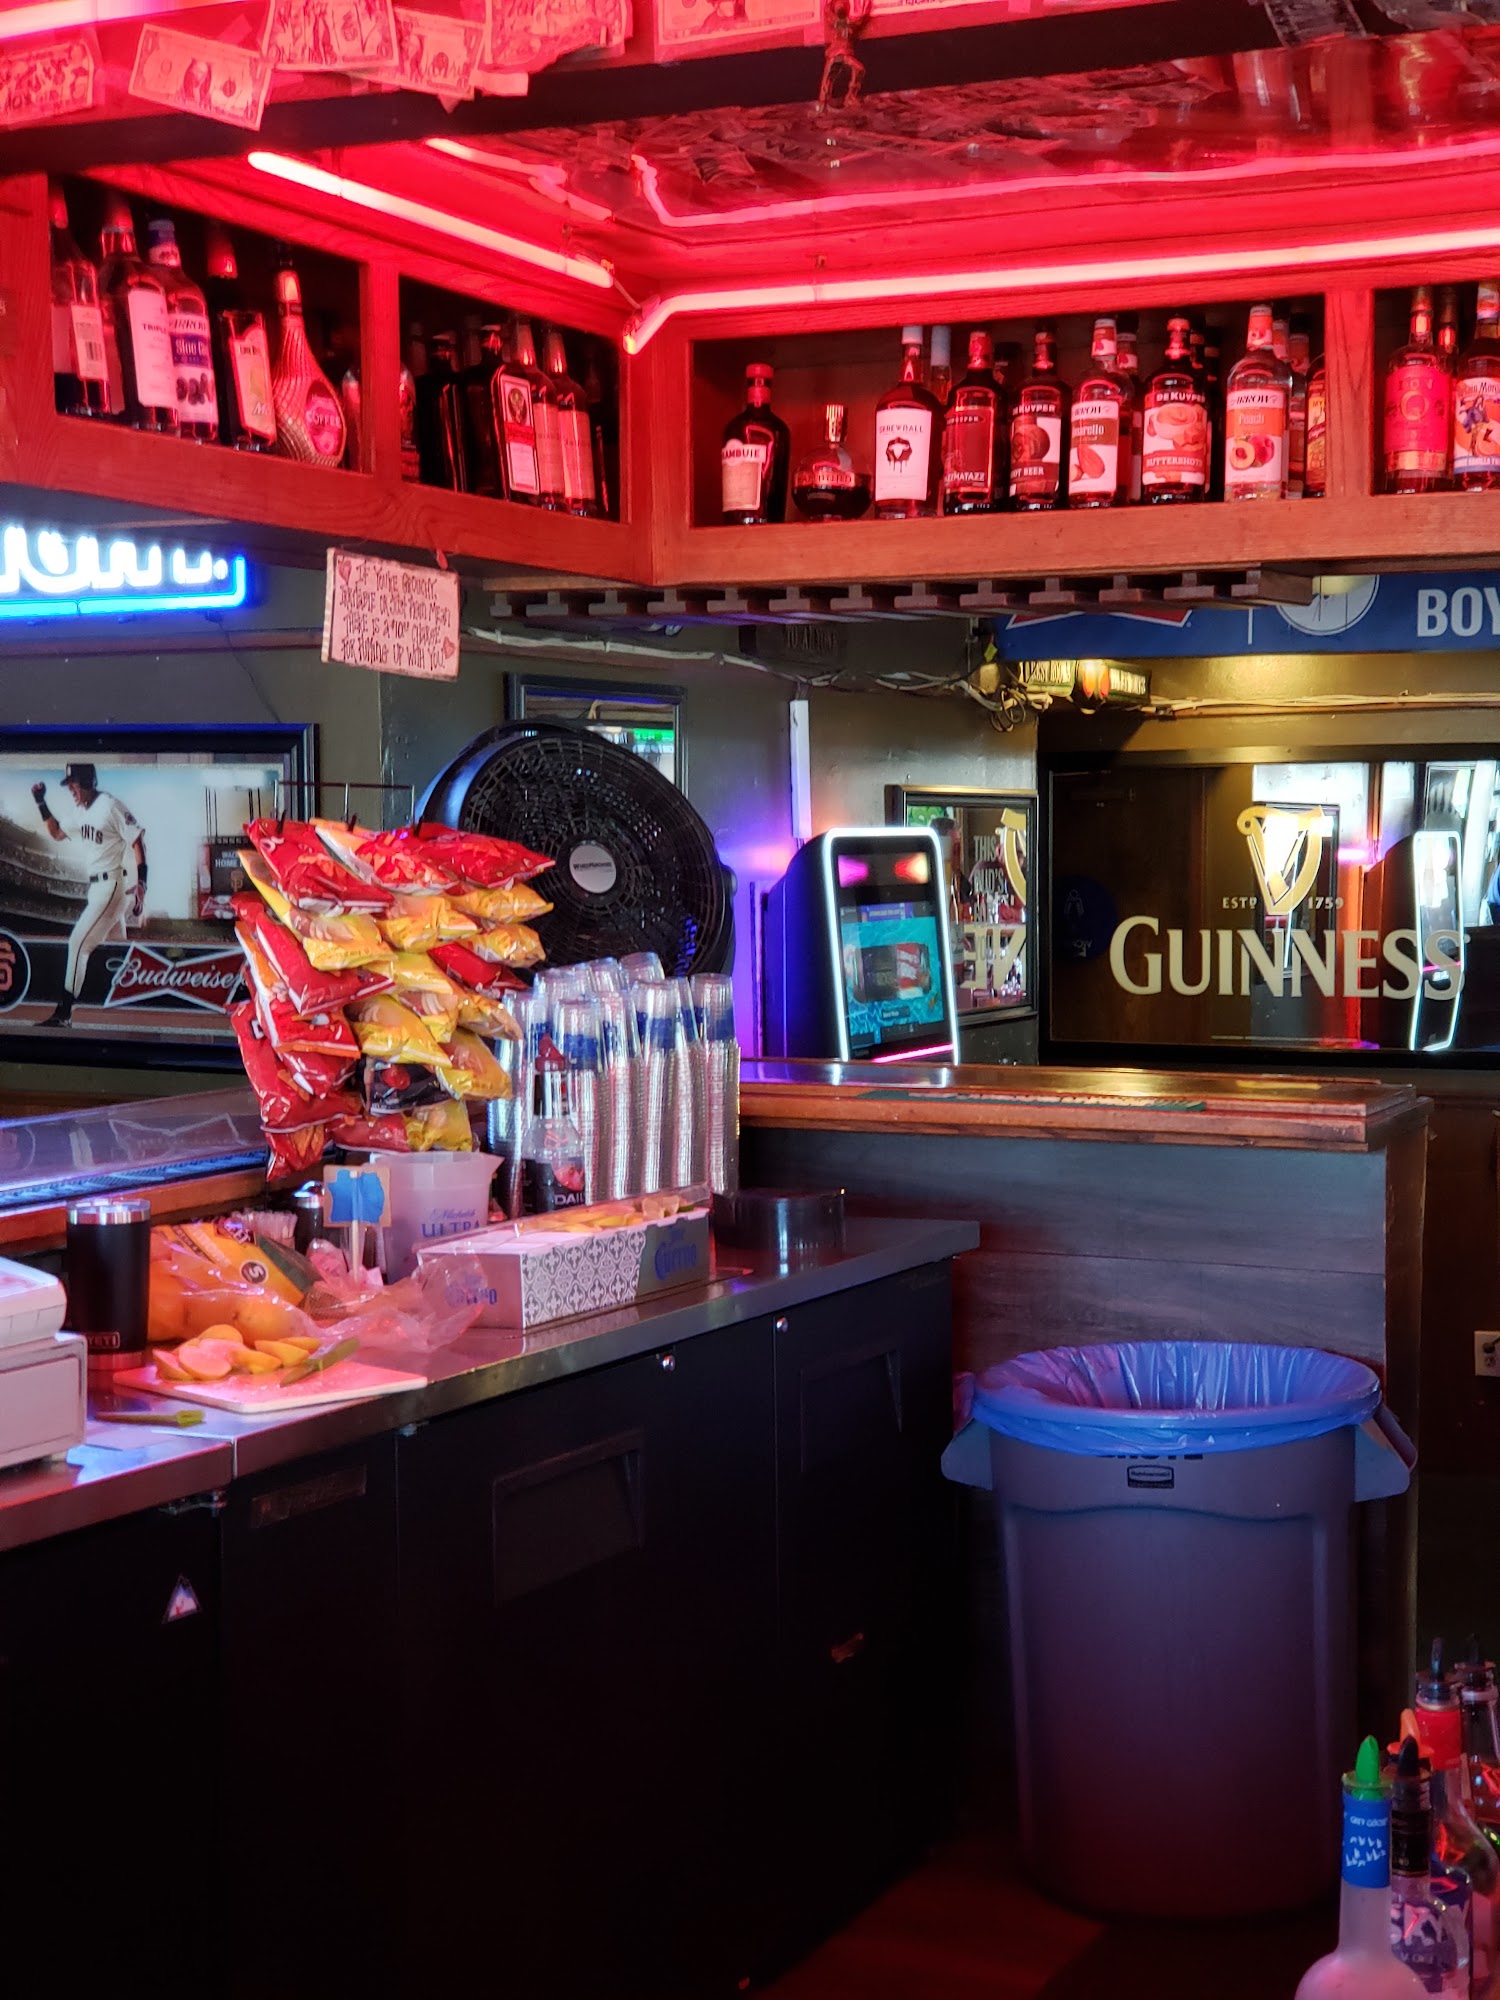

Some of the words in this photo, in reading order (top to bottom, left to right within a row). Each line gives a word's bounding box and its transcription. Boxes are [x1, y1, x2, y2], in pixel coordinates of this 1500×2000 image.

[973, 834, 997, 862] THIS
[1307, 896, 1344, 910] 1759
[1110, 915, 1466, 1001] GUINNESS
[106, 957, 247, 990] Budweiser
[421, 1219, 480, 1239] ULTRA
